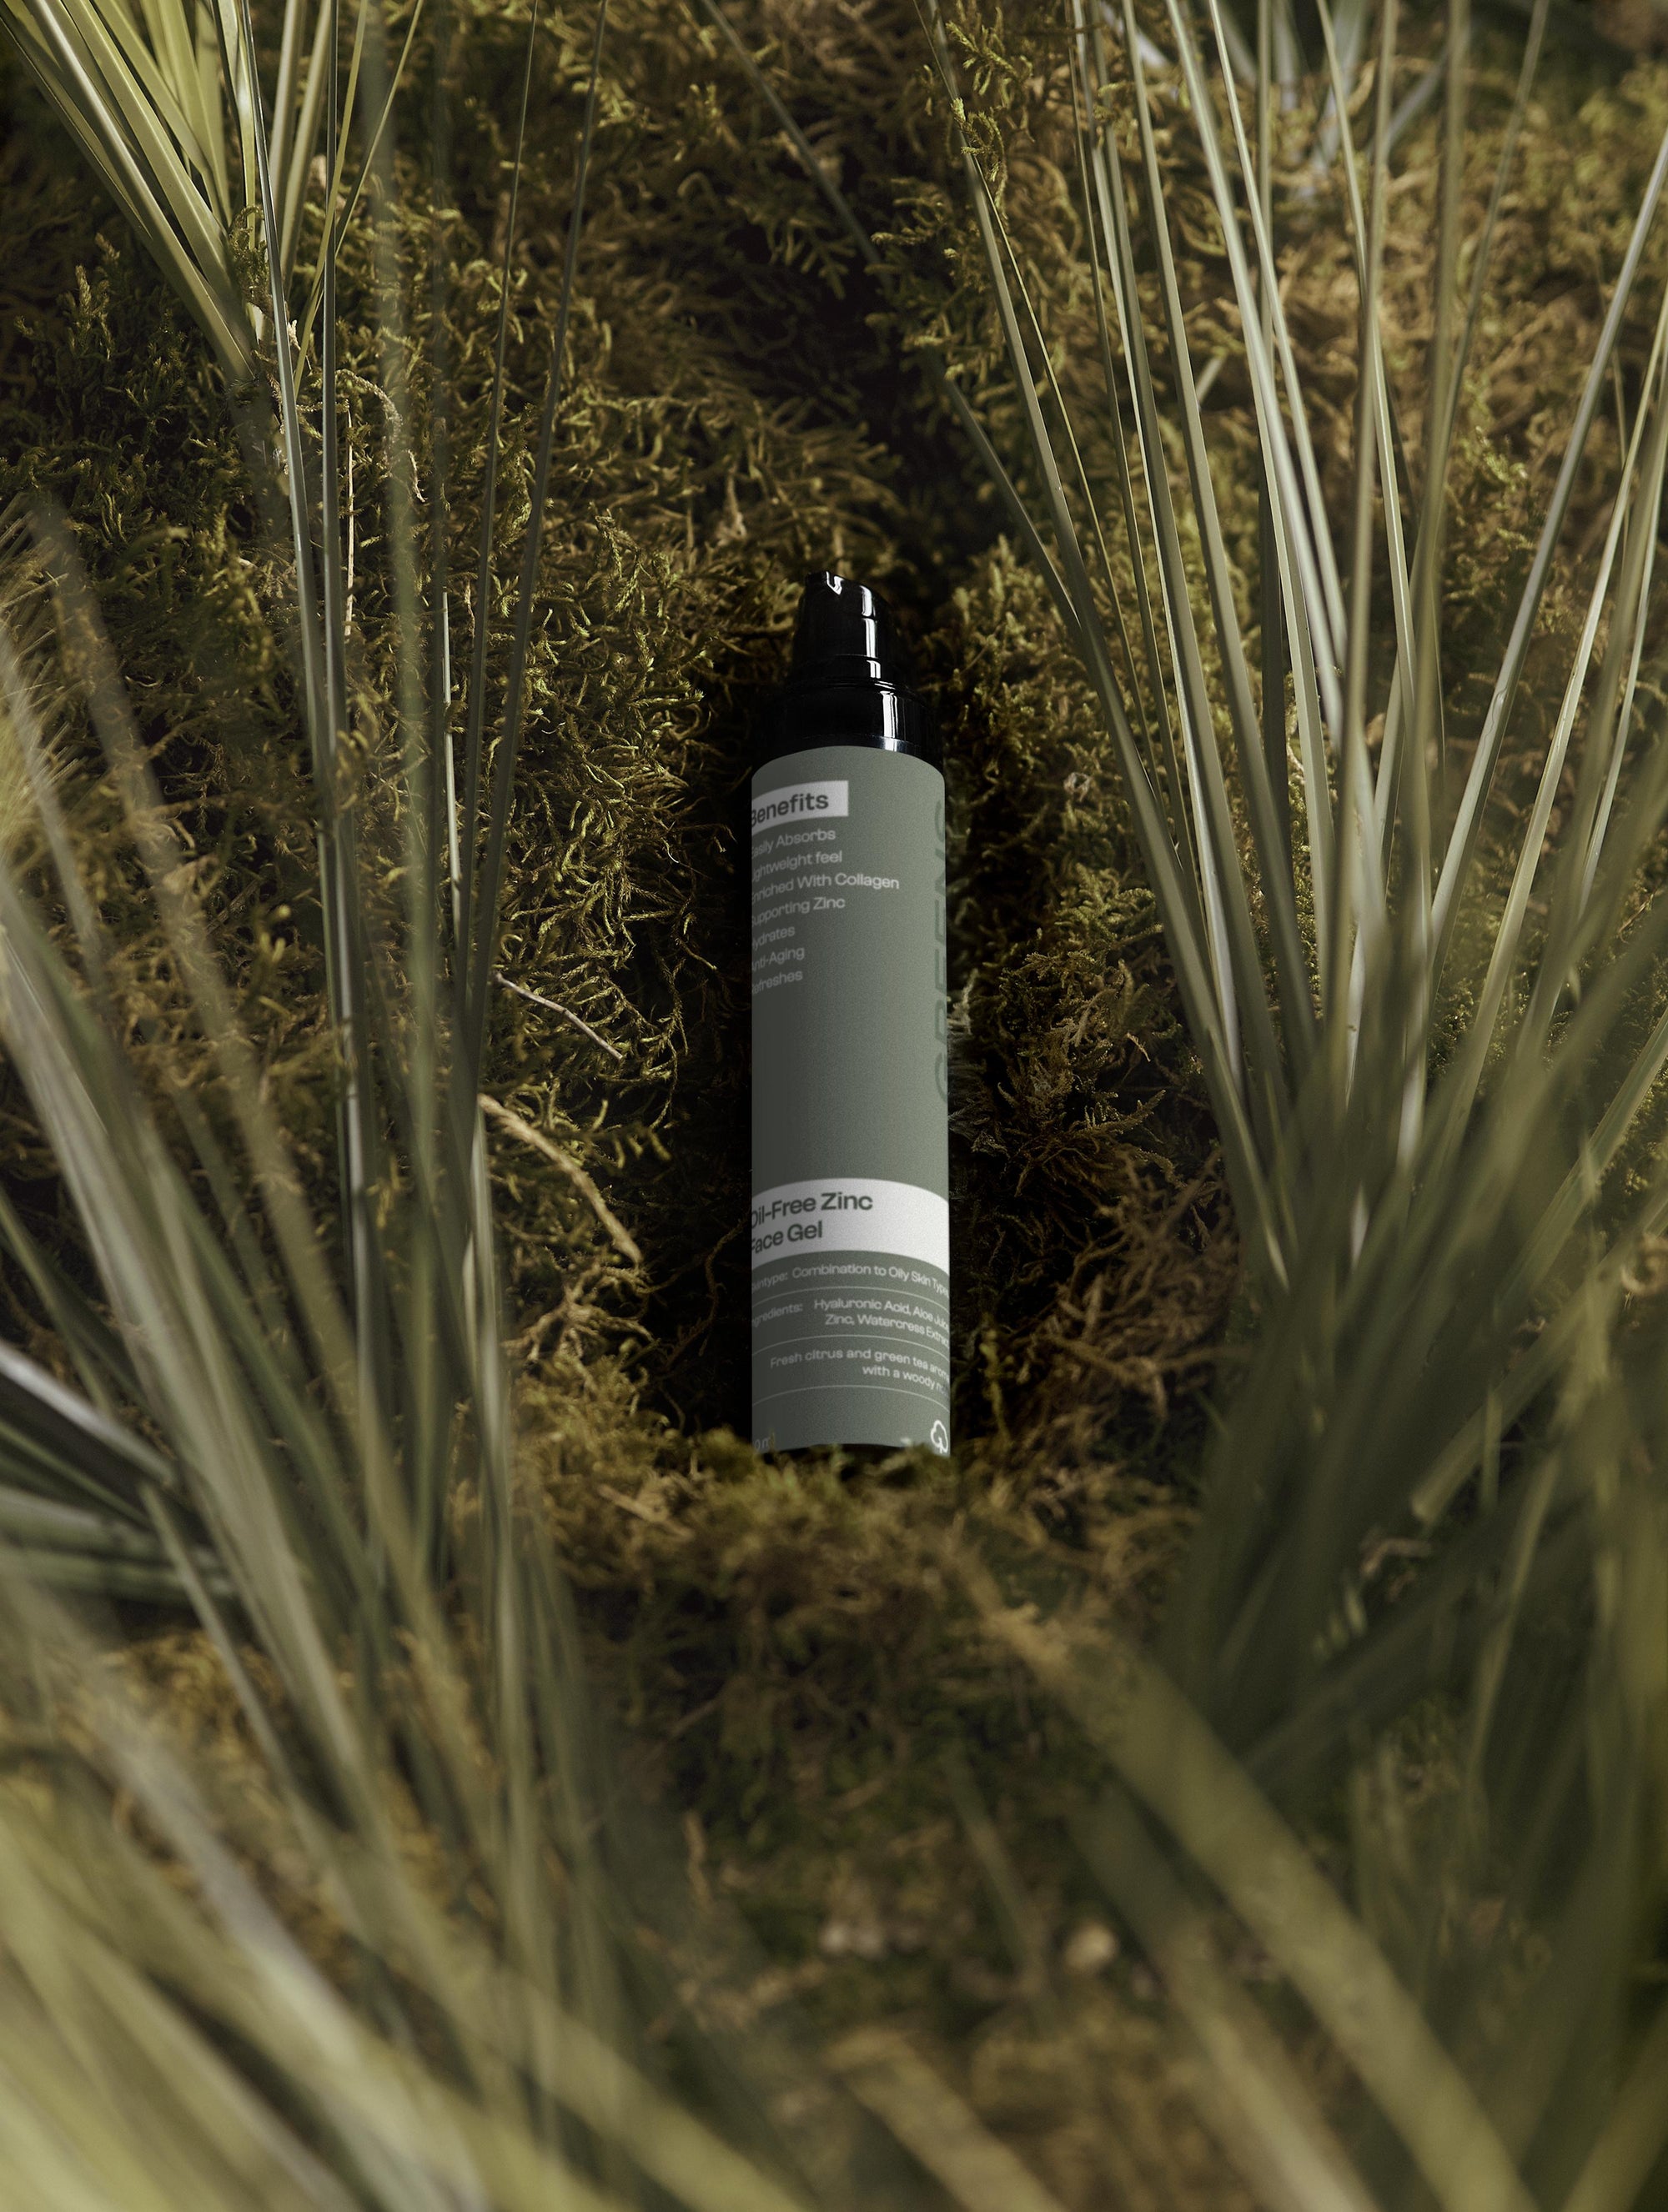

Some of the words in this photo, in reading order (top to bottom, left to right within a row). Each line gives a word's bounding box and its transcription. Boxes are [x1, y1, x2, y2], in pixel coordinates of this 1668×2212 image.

[751, 793, 829, 828] Benefits
[776, 828, 836, 849] Absorbs
[816, 850, 842, 864] feel
[797, 875, 831, 890] With
[835, 872, 900, 890] Collagen
[813, 896, 846, 910] Zinc
[821, 1191, 873, 1211] Zinc
[787, 1221, 822, 1242] Gel
[792, 1263, 871, 1278] Combination
[873, 1266, 887, 1277] to
[888, 1266, 909, 1282] Oily
[911, 1270, 931, 1287] Skin
[814, 1298, 882, 1312] Hyaluronic
[884, 1300, 912, 1316] Acid,
[912, 1306, 933, 1322] Aloe
[825, 1313, 855, 1326] Zinc,
[857, 1314, 926, 1334] Watercress
[771, 1352, 802, 1368] Fresh
[805, 1350, 843, 1361] citrus
[846, 1348, 872, 1359] and
[874, 1352, 911, 1362] green
[912, 1357, 928, 1369] tea
[862, 1366, 890, 1377] with
[893, 1369, 901, 1378] a
[902, 1371, 935, 1390] woody
